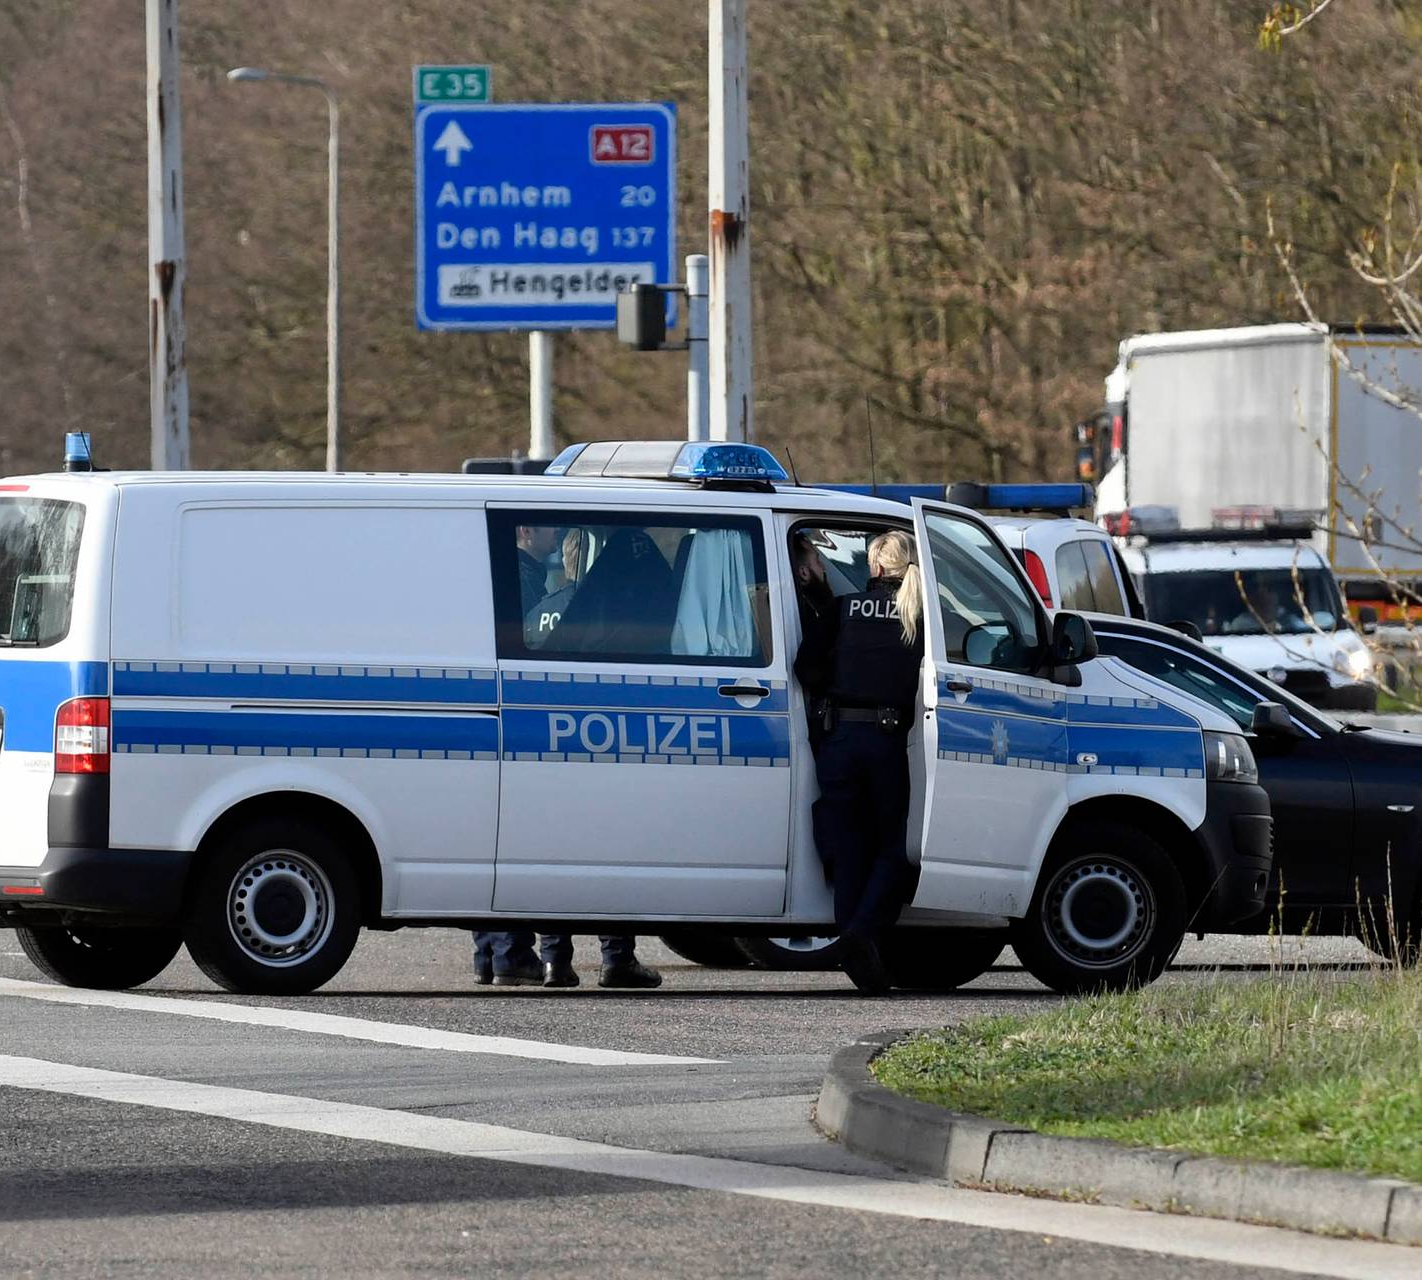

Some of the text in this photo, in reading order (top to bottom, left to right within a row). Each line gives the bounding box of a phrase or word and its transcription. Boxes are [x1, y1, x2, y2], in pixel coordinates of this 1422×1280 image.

[435, 181, 656, 207] Arnhem 20
[436, 222, 656, 255] Den Haag 137
[849, 599, 901, 619] POLIZ
[548, 712, 731, 756] POLIZEI
